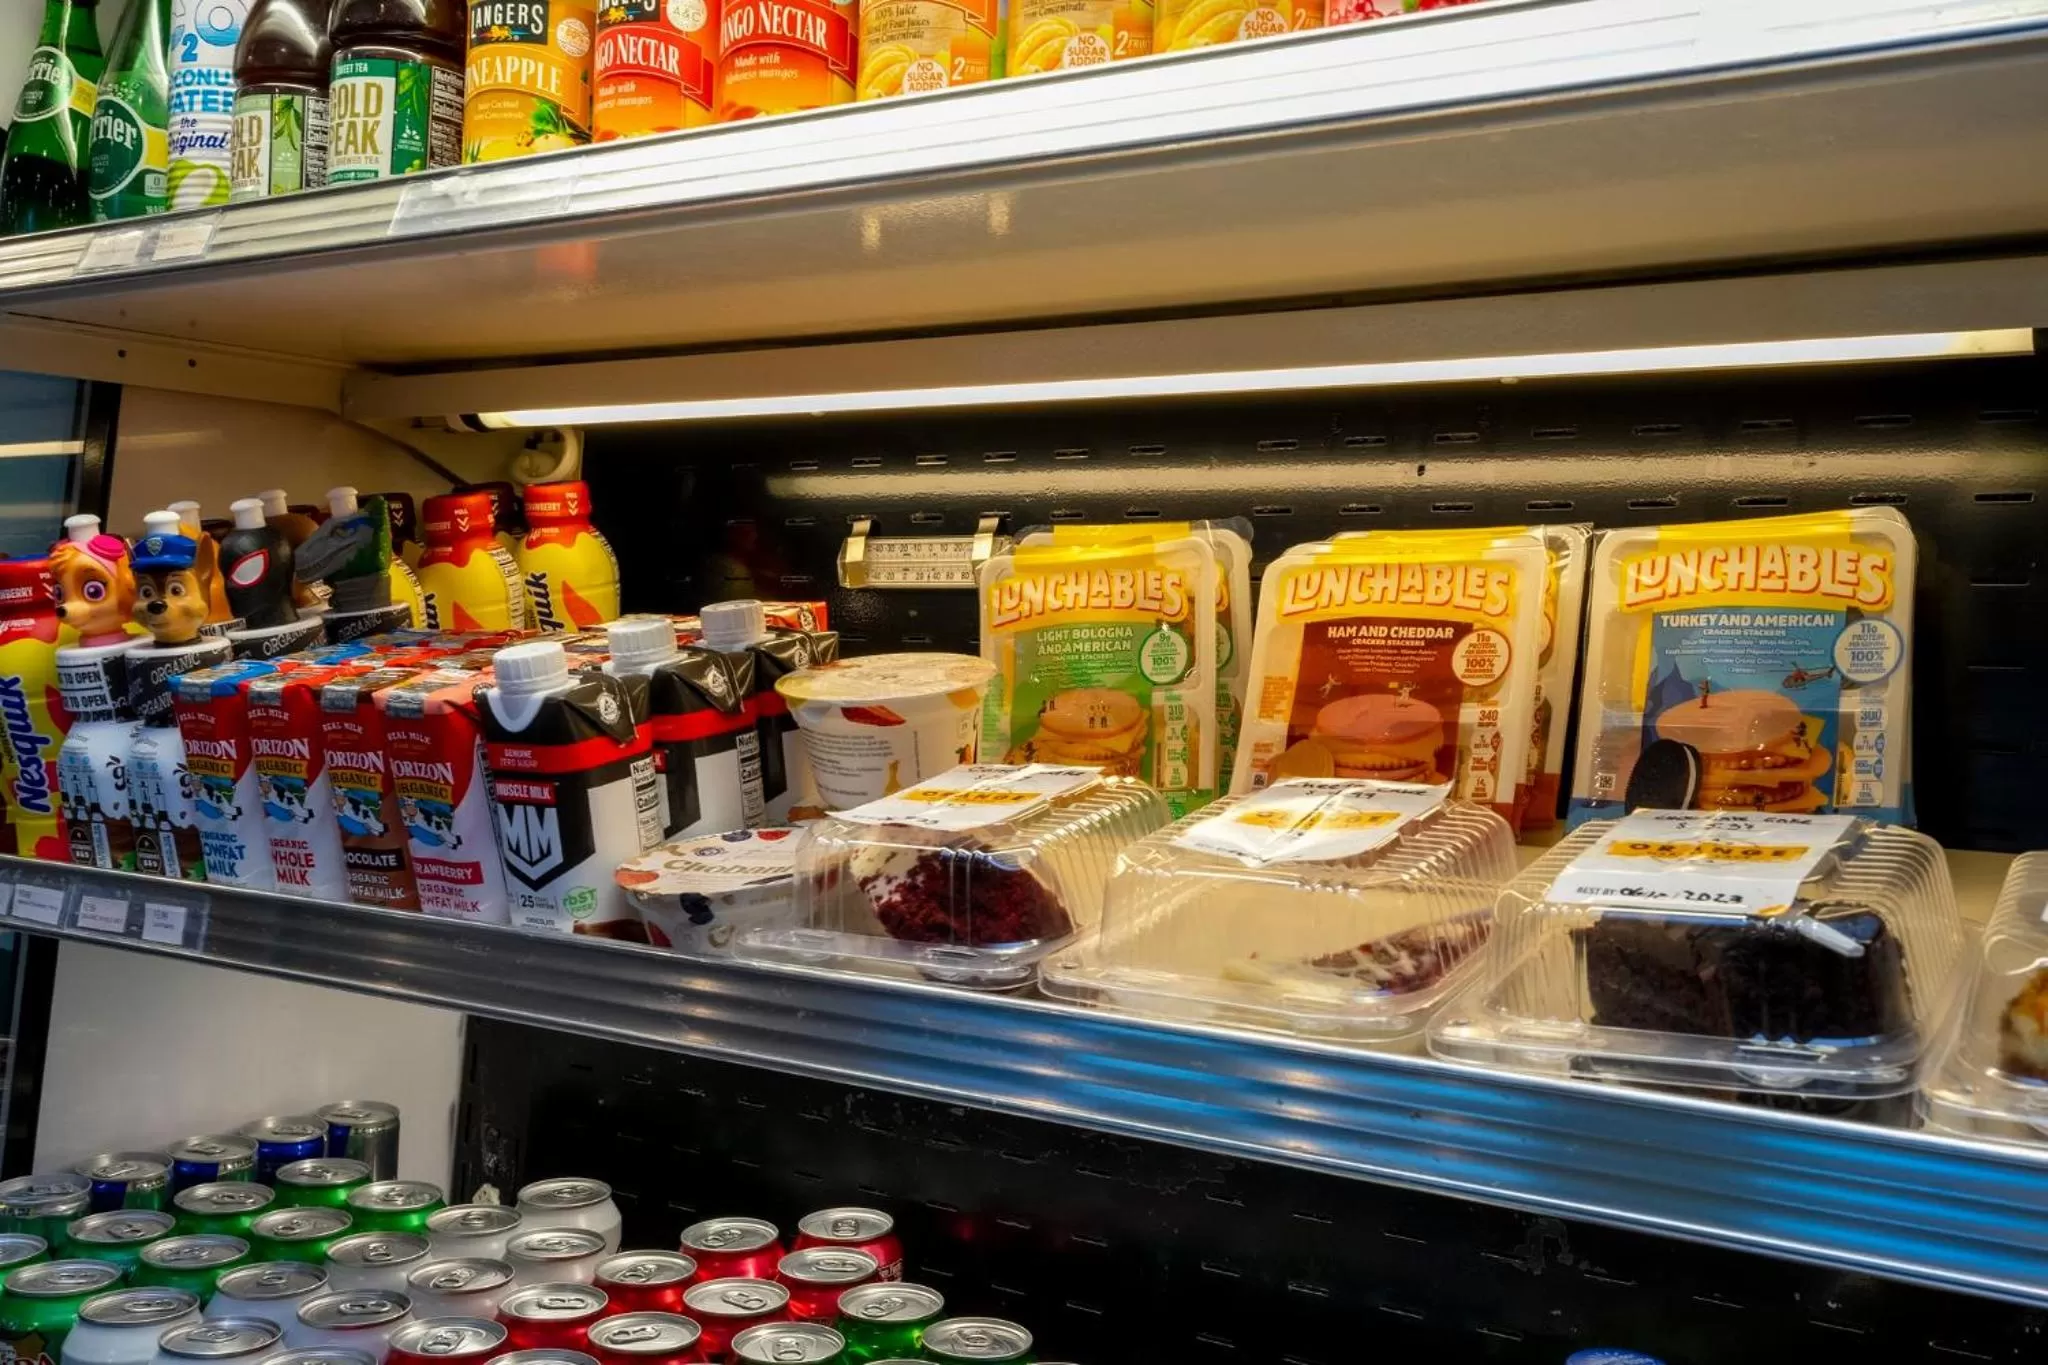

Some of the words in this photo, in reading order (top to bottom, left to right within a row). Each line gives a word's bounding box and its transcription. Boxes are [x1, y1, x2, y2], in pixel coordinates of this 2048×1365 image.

[471, 3, 545, 38] LANGERS
[1255, 10, 1274, 21] NO
[758, 0, 828, 50] NECTAR
[1077, 35, 1096, 46] NO
[616, 33, 681, 76] NECTAR
[1068, 46, 1106, 57] SUGAR
[916, 62, 934, 72] NO
[907, 72, 943, 82] SUGAR
[180, 117, 198, 128] the
[1625, 543, 1889, 608] LUNCHABLES
[1282, 562, 1511, 617] LUNCHABLES
[992, 568, 1183, 628] LUNCHABLES
[1661, 614, 1718, 627] TURKEY
[1719, 614, 1750, 627] AND
[1753, 613, 1835, 627] AMERICAN
[1036, 630, 1070, 643] LIGHT
[1072, 626, 1133, 640] BOLOGNA
[1328, 626, 1357, 638] HAM
[1359, 625, 1387, 638] AND
[1390, 626, 1455, 639] CHEDDAR
[1064, 640, 1131, 654] AMERICAN
[1466, 658, 1495, 668] 100%
[1852, 650, 1885, 662] 100%
[75, 670, 102, 684] OPEN
[82, 693, 109, 707] OPEN
[1479, 709, 1499, 721] 340
[208, 859, 239, 878] MILK
[276, 868, 310, 886] MILK
[454, 898, 481, 912] MILK
[520, 894, 535, 909] 25
